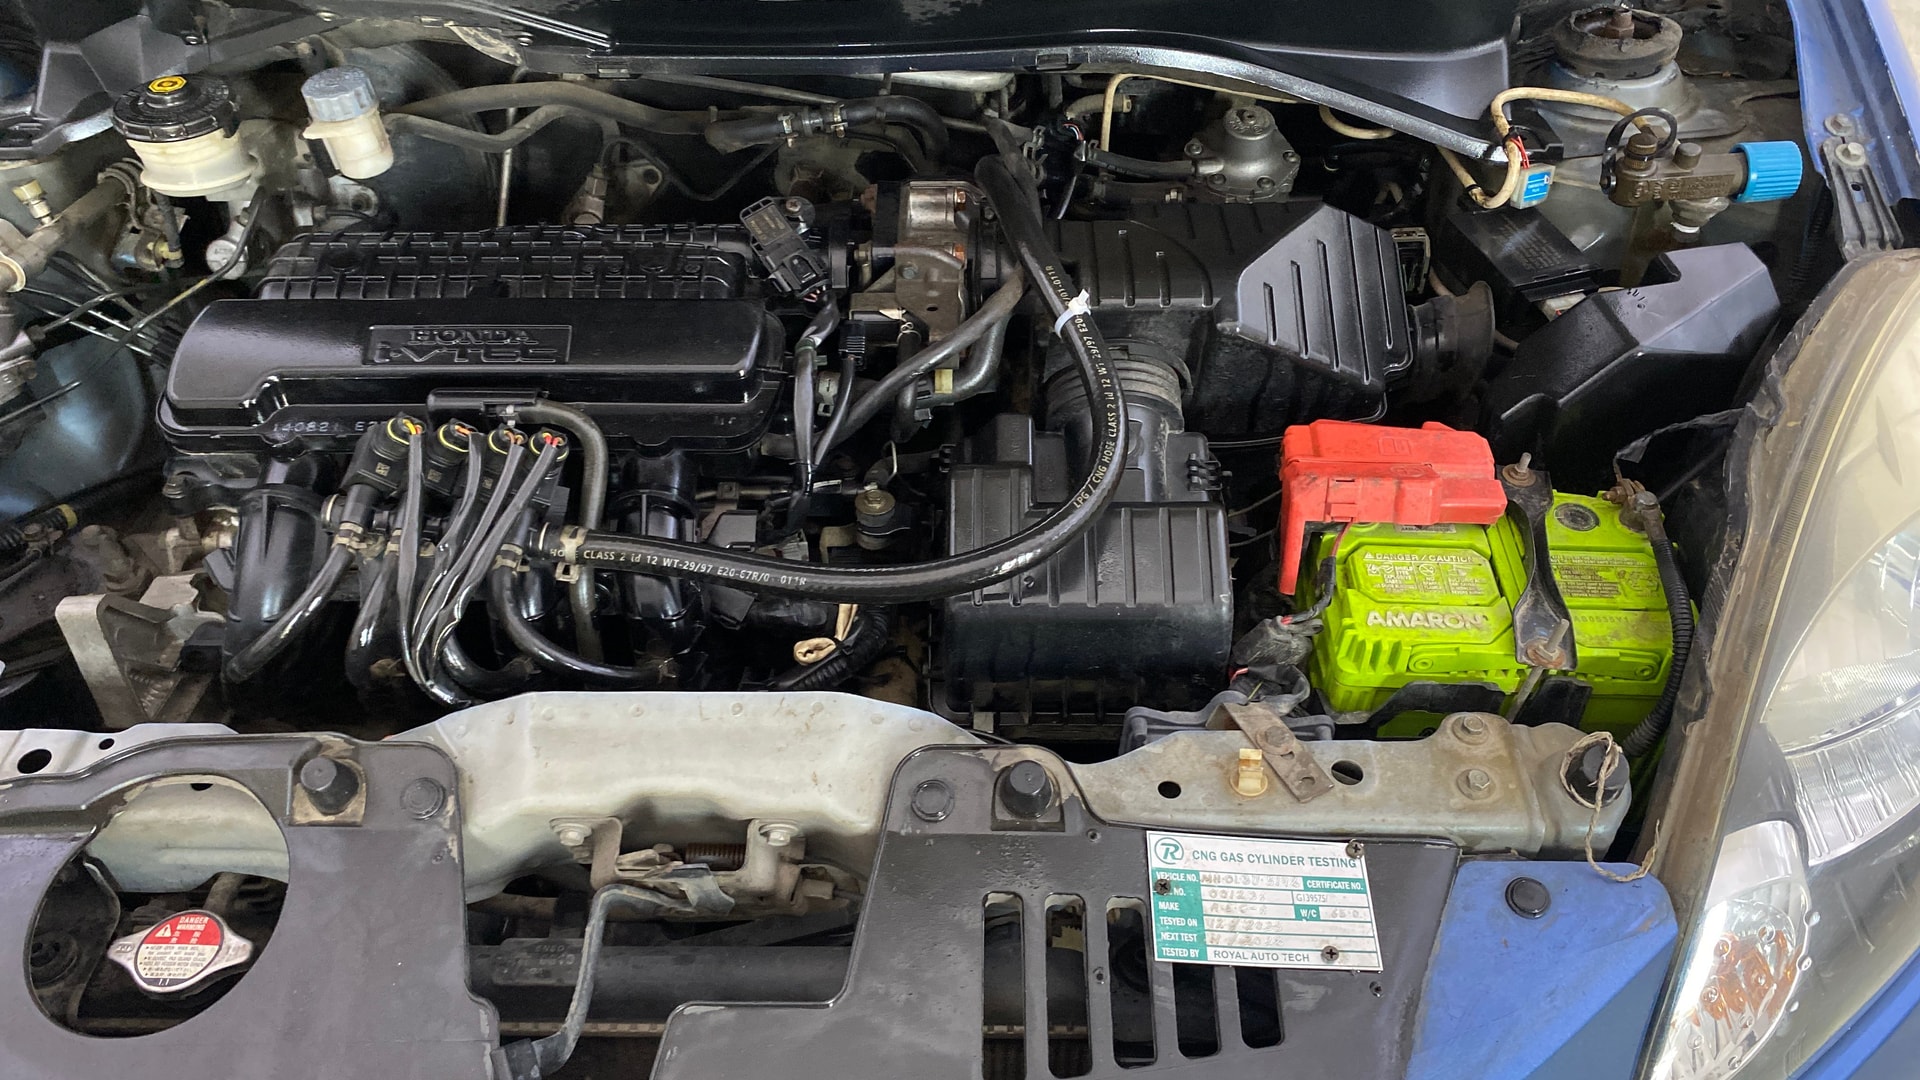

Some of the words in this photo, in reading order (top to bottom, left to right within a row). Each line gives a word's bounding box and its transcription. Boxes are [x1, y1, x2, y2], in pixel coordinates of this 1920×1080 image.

[408, 330, 539, 345] HONDA
[1101, 378, 1112, 388] 12
[1107, 412, 1117, 437] CLASS
[1101, 441, 1115, 463] HOSE
[1092, 465, 1107, 484] CNG
[1073, 491, 1090, 509] LPG
[583, 550, 615, 561] CLASS
[620, 552, 626, 562] 2
[631, 553, 641, 563] id
[646, 554, 658, 565] 12
[663, 557, 713, 574] WT-29/97
[1376, 553, 1418, 561] DANGER
[1367, 611, 1483, 630] AMARON
[1192, 850, 1217, 861] CNG
[1220, 851, 1244, 863] GAS
[1247, 853, 1306, 867] CYLINDER
[1308, 856, 1357, 869] TESTING
[1156, 871, 1185, 881] VEHICLE
[1186, 873, 1199, 882] NO.
[1306, 880, 1350, 890] CERTIFICATE
[1351, 882, 1364, 890] NO.
[1158, 901, 1180, 911] MAKE
[1300, 908, 1317, 918] W/C
[179, 916, 209, 924] DANGER
[1187, 918, 1198, 927] ON
[1160, 932, 1179, 941] NEXT
[1180, 933, 1197, 942] TEST
[1162, 947, 1189, 957] TESTED
[1190, 949, 1200, 958] BY
[1213, 950, 1248, 961] ROYAL
[1251, 951, 1280, 962] AUTO
[1281, 952, 1310, 963] TECH
